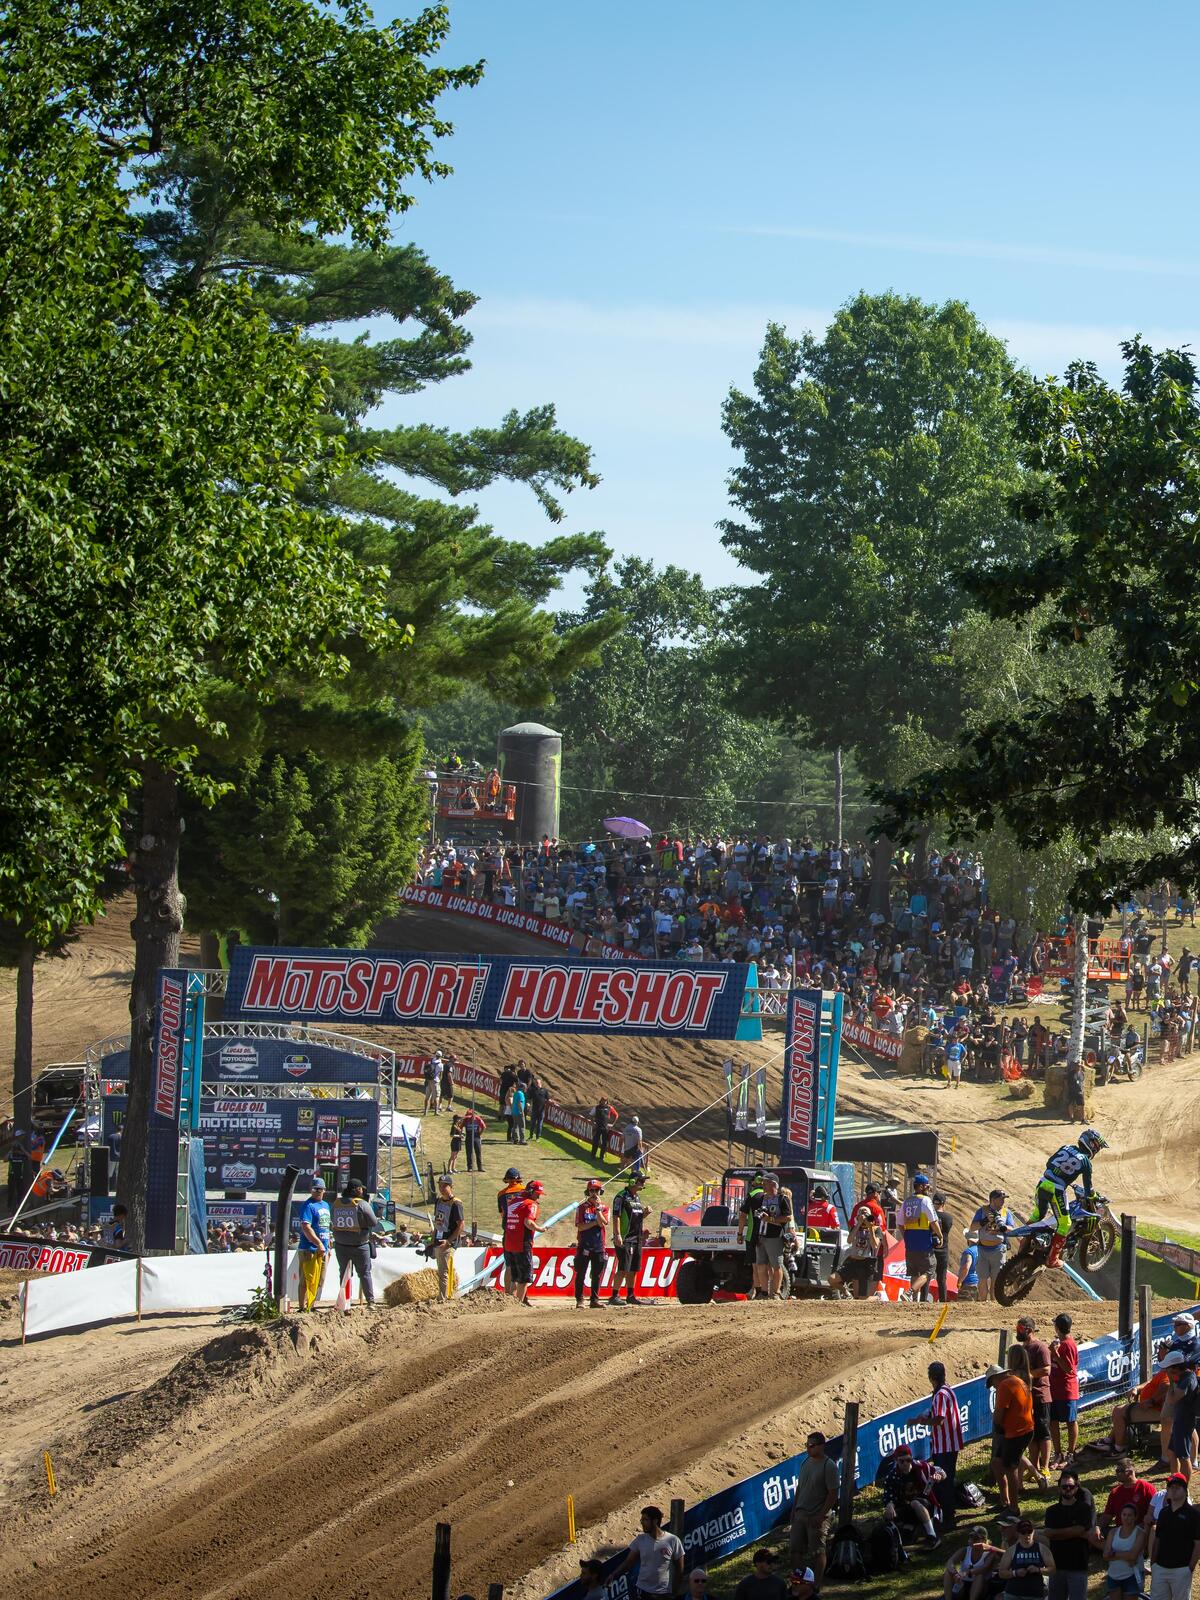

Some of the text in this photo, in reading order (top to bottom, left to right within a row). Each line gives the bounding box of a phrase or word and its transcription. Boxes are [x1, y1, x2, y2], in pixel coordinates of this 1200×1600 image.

[398, 886, 427, 902] UCAS
[427, 892, 443, 906] OIL
[447, 896, 478, 914] LUCAS
[478, 904, 494, 918] OIL
[496, 909, 525, 929] LUCAS
[526, 918, 539, 933] OIL
[541, 923, 569, 943] LUCAS
[497, 965, 726, 1029] HOLESHOT
[841, 1022, 858, 1041] UCAS
[859, 1029, 871, 1045] OIL
[873, 1035, 897, 1057] LUCAS
[216, 1102, 265, 1112] LUCAS OIL
[198, 1117, 282, 1129] MOTOCROSS
[1051, 1150, 1082, 1175] 28
[336, 1216, 354, 1228] 80
[905, 1205, 918, 1217] 87
[694, 1236, 730, 1244] Kawasaki
[485, 1255, 575, 1287] LCAS
[704, 1527, 747, 1552] MOTORCYCLES
